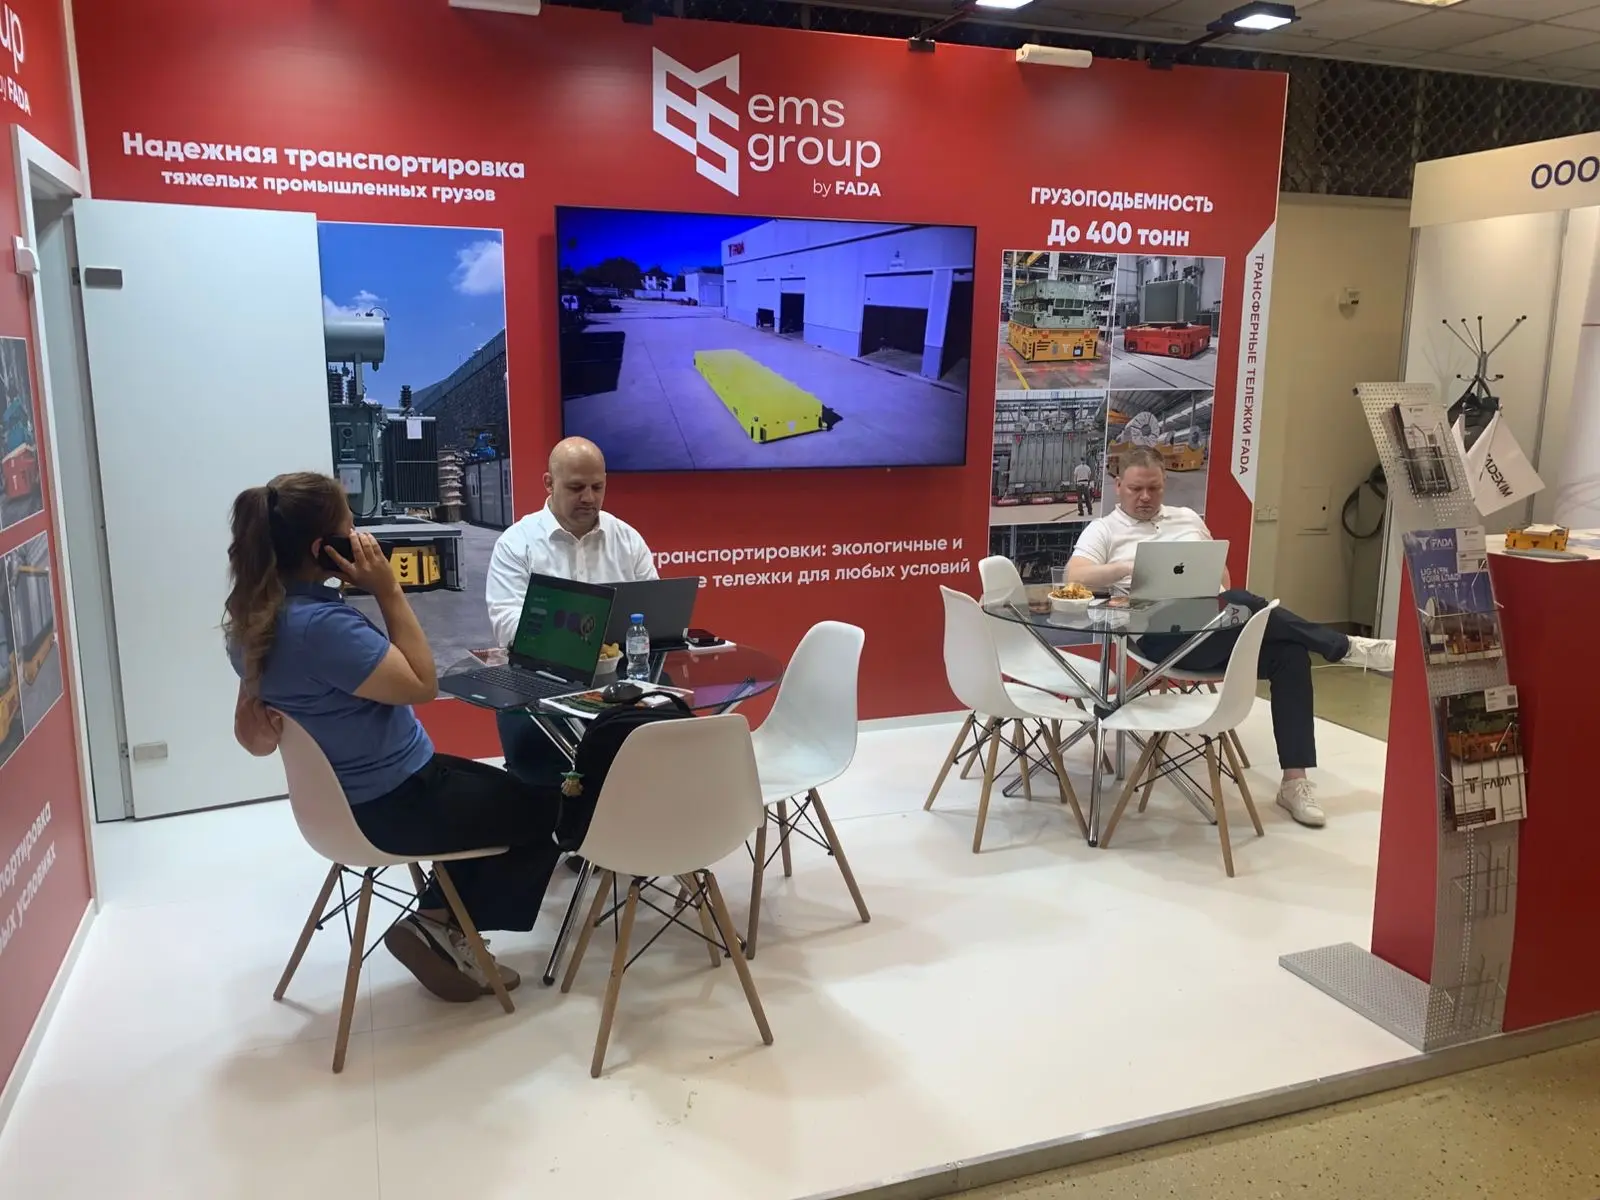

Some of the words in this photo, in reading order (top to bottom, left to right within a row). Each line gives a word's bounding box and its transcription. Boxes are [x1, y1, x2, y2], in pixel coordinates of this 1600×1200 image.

[7, 76, 32, 117] FADA
[747, 93, 845, 128] ems
[122, 131, 278, 164] Надежная
[284, 148, 525, 180] транспортировка
[747, 132, 882, 177] group
[161, 171, 258, 189] тяжелых
[263, 176, 427, 198] промышленных
[432, 186, 496, 203] грузов
[813, 179, 832, 198] by
[835, 181, 882, 197] FADA
[1047, 219, 1081, 246] До
[1085, 220, 1132, 245] 400
[1138, 228, 1190, 247] тонн
[1247, 253, 1264, 364] ТРАНСФЕРНЫЕ
[1242, 367, 1257, 434] ТЕЛЕЖКИ
[1239, 437, 1251, 475] FADA
[1485, 453, 1514, 498] ADEXIM
[831, 537, 948, 557] экологичные
[952, 537, 963, 551] и
[712, 569, 793, 588] тележки
[797, 567, 830, 585] для
[834, 562, 896, 580] любых
[900, 558, 971, 580] условий
